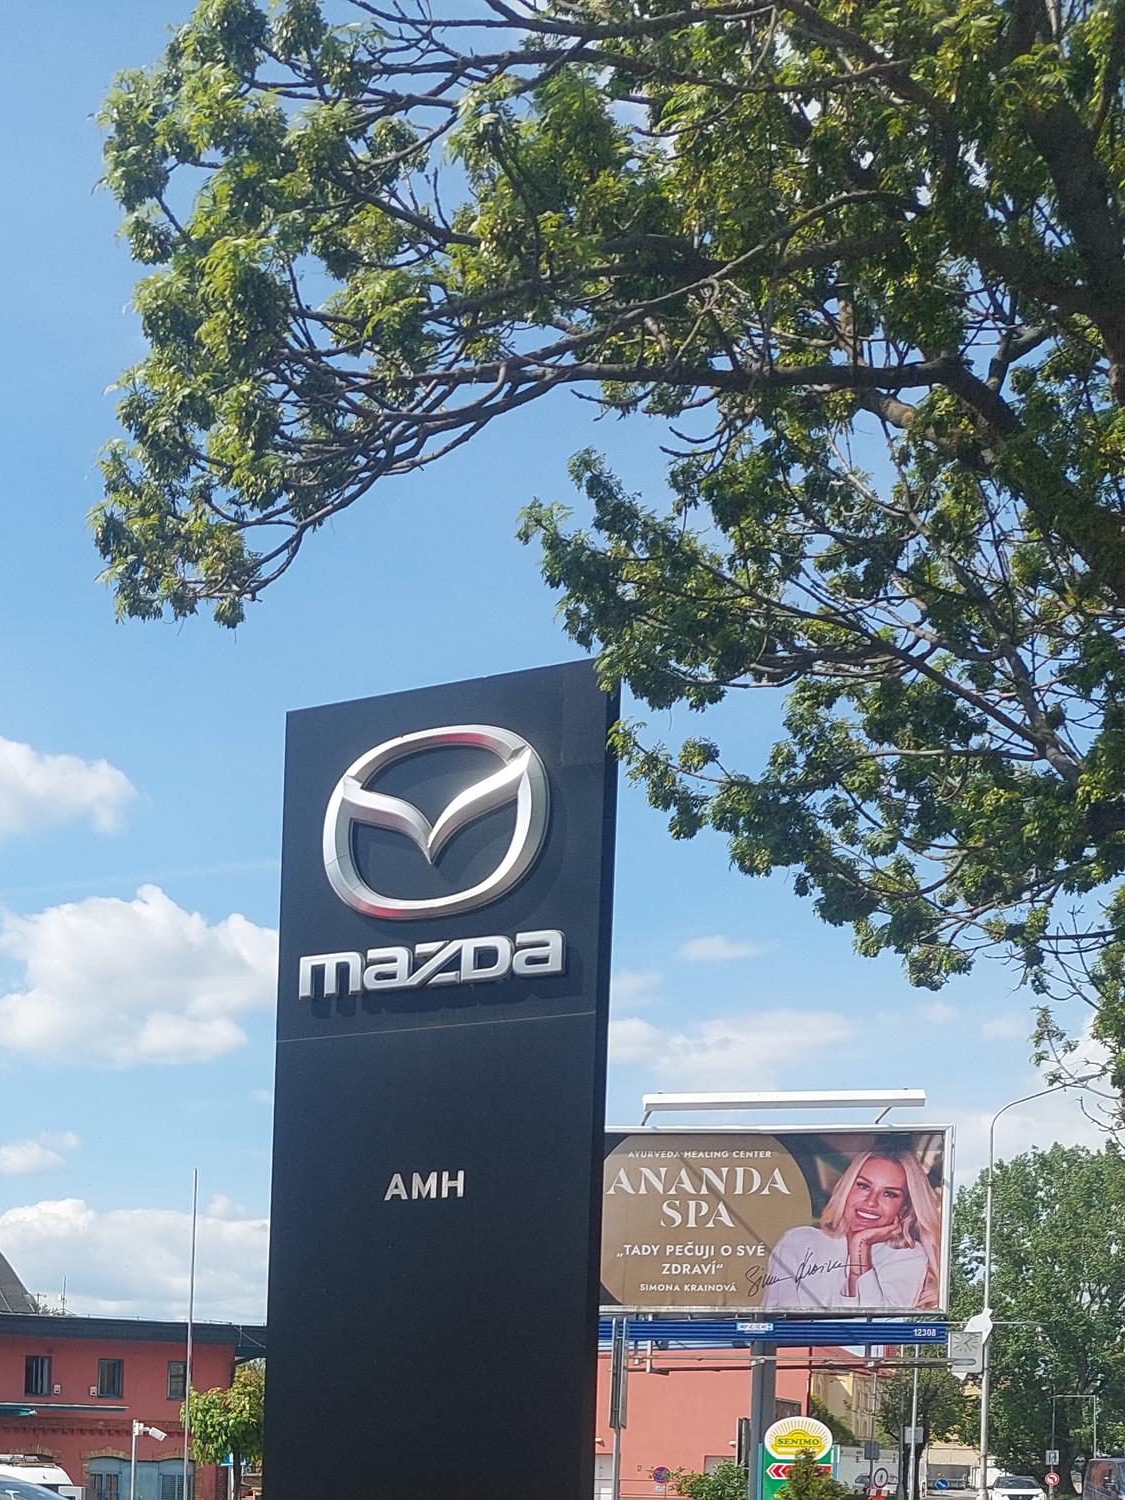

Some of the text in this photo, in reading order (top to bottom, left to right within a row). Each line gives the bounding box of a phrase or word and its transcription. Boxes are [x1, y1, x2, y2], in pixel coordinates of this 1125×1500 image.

[627, 1150, 772, 1159] AYURVEDA HEALING CENTER
[383, 1170, 465, 1201] AMH
[605, 1167, 791, 1195] ANANDA
[660, 1199, 735, 1228] SPA
[666, 1241, 715, 1259] PEČUJI
[720, 1244, 733, 1257] O
[736, 1241, 766, 1257] SVÉ
[639, 1281, 737, 1292] SIMONA KRAINOVÁ
[913, 1328, 937, 1337] 12308
[777, 1438, 821, 1446] SENIMO
